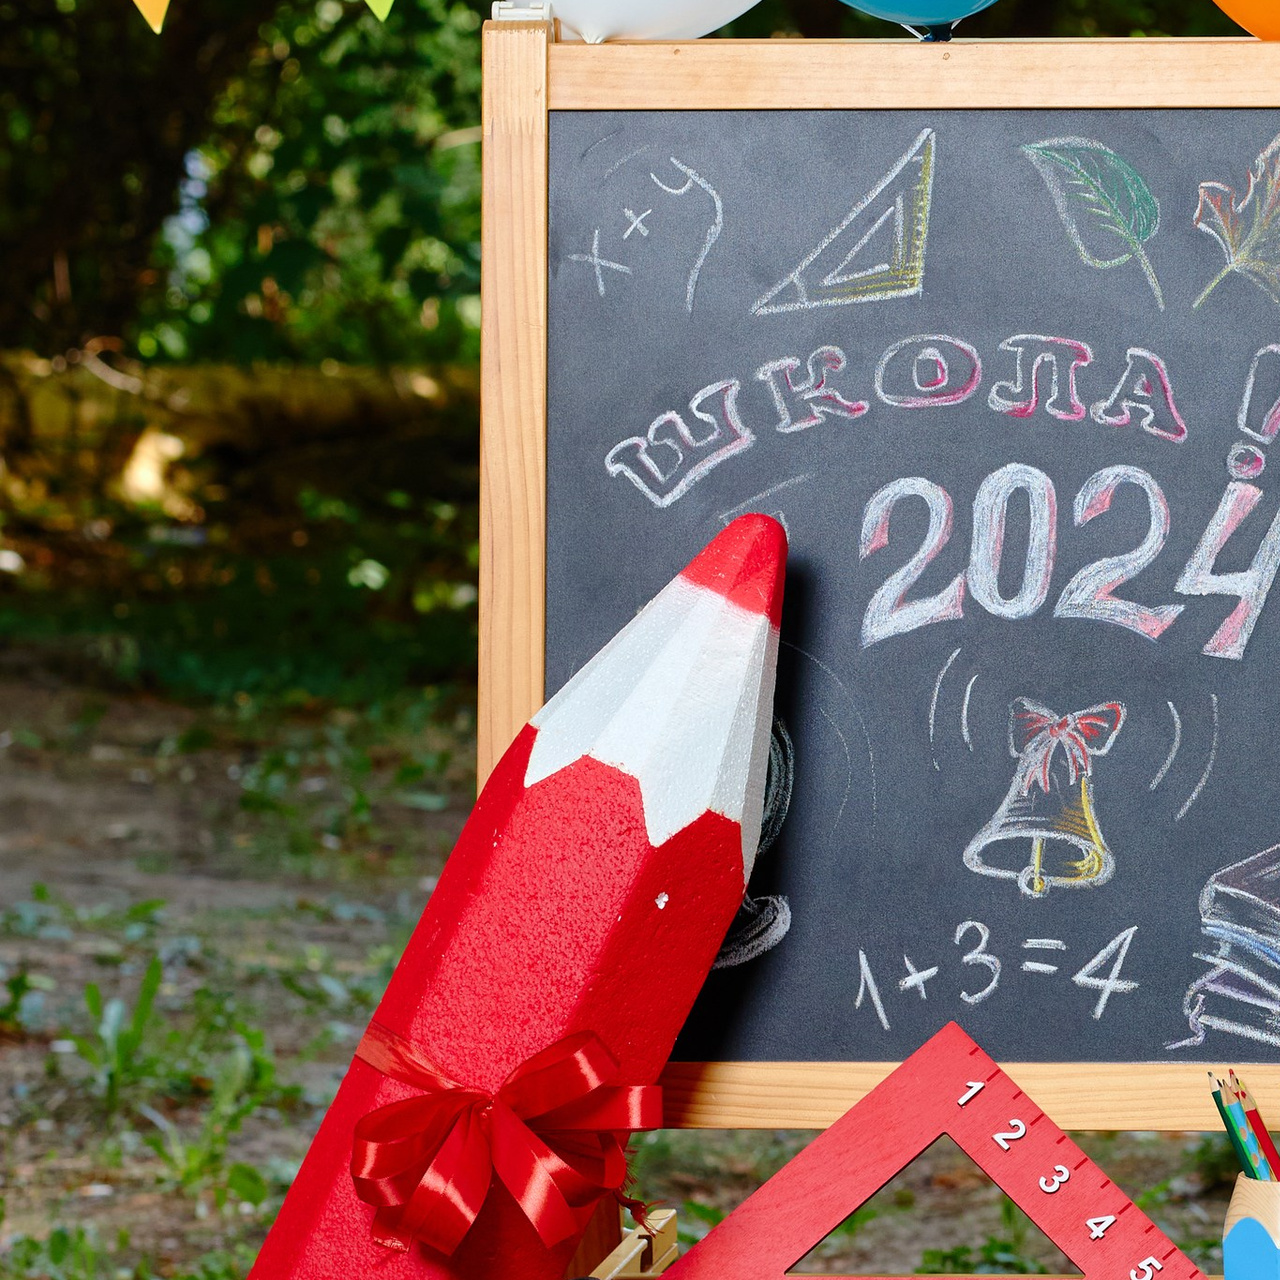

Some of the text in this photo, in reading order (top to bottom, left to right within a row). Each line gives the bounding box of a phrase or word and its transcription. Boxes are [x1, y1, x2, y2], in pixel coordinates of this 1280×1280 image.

[956, 1079, 986, 1108] 1
[992, 1119, 1027, 1152] 2
[1038, 1164, 1070, 1194] 3
[1084, 1212, 1118, 1242] 4
